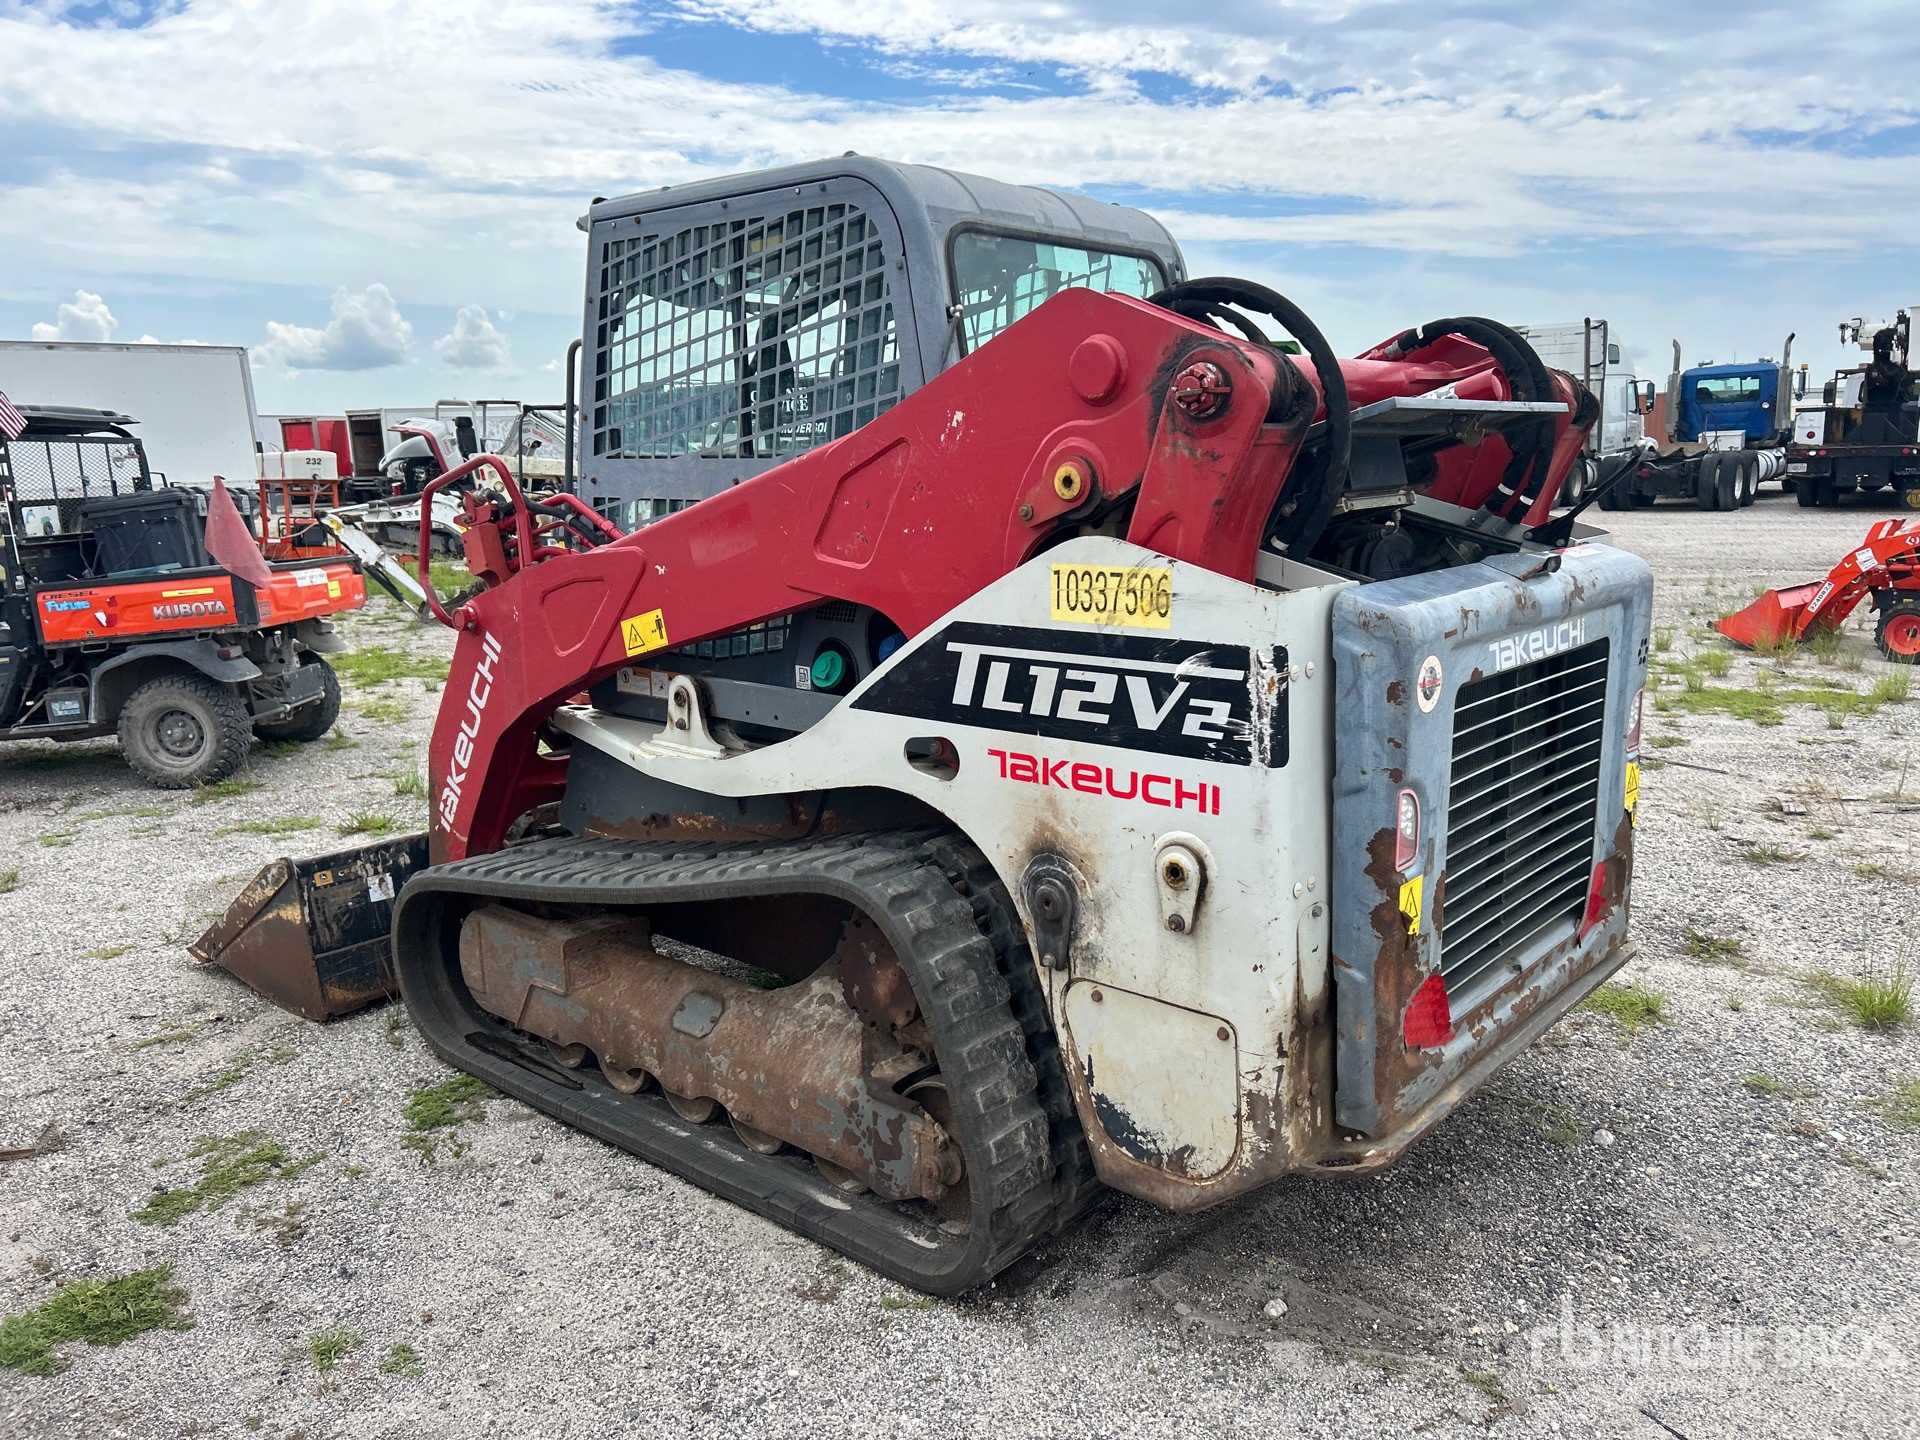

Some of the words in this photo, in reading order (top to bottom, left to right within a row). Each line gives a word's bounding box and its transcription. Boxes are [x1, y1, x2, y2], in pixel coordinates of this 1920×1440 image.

[306, 457, 322, 465] 232
[42, 590, 100, 600] DIESEL
[153, 600, 228, 619] KUBOTA
[1053, 569, 1170, 618] 10337506
[1489, 617, 1585, 672] TAKEUCHI
[946, 641, 1245, 740] TL12V2
[987, 748, 1221, 816] TAKEUCHI
